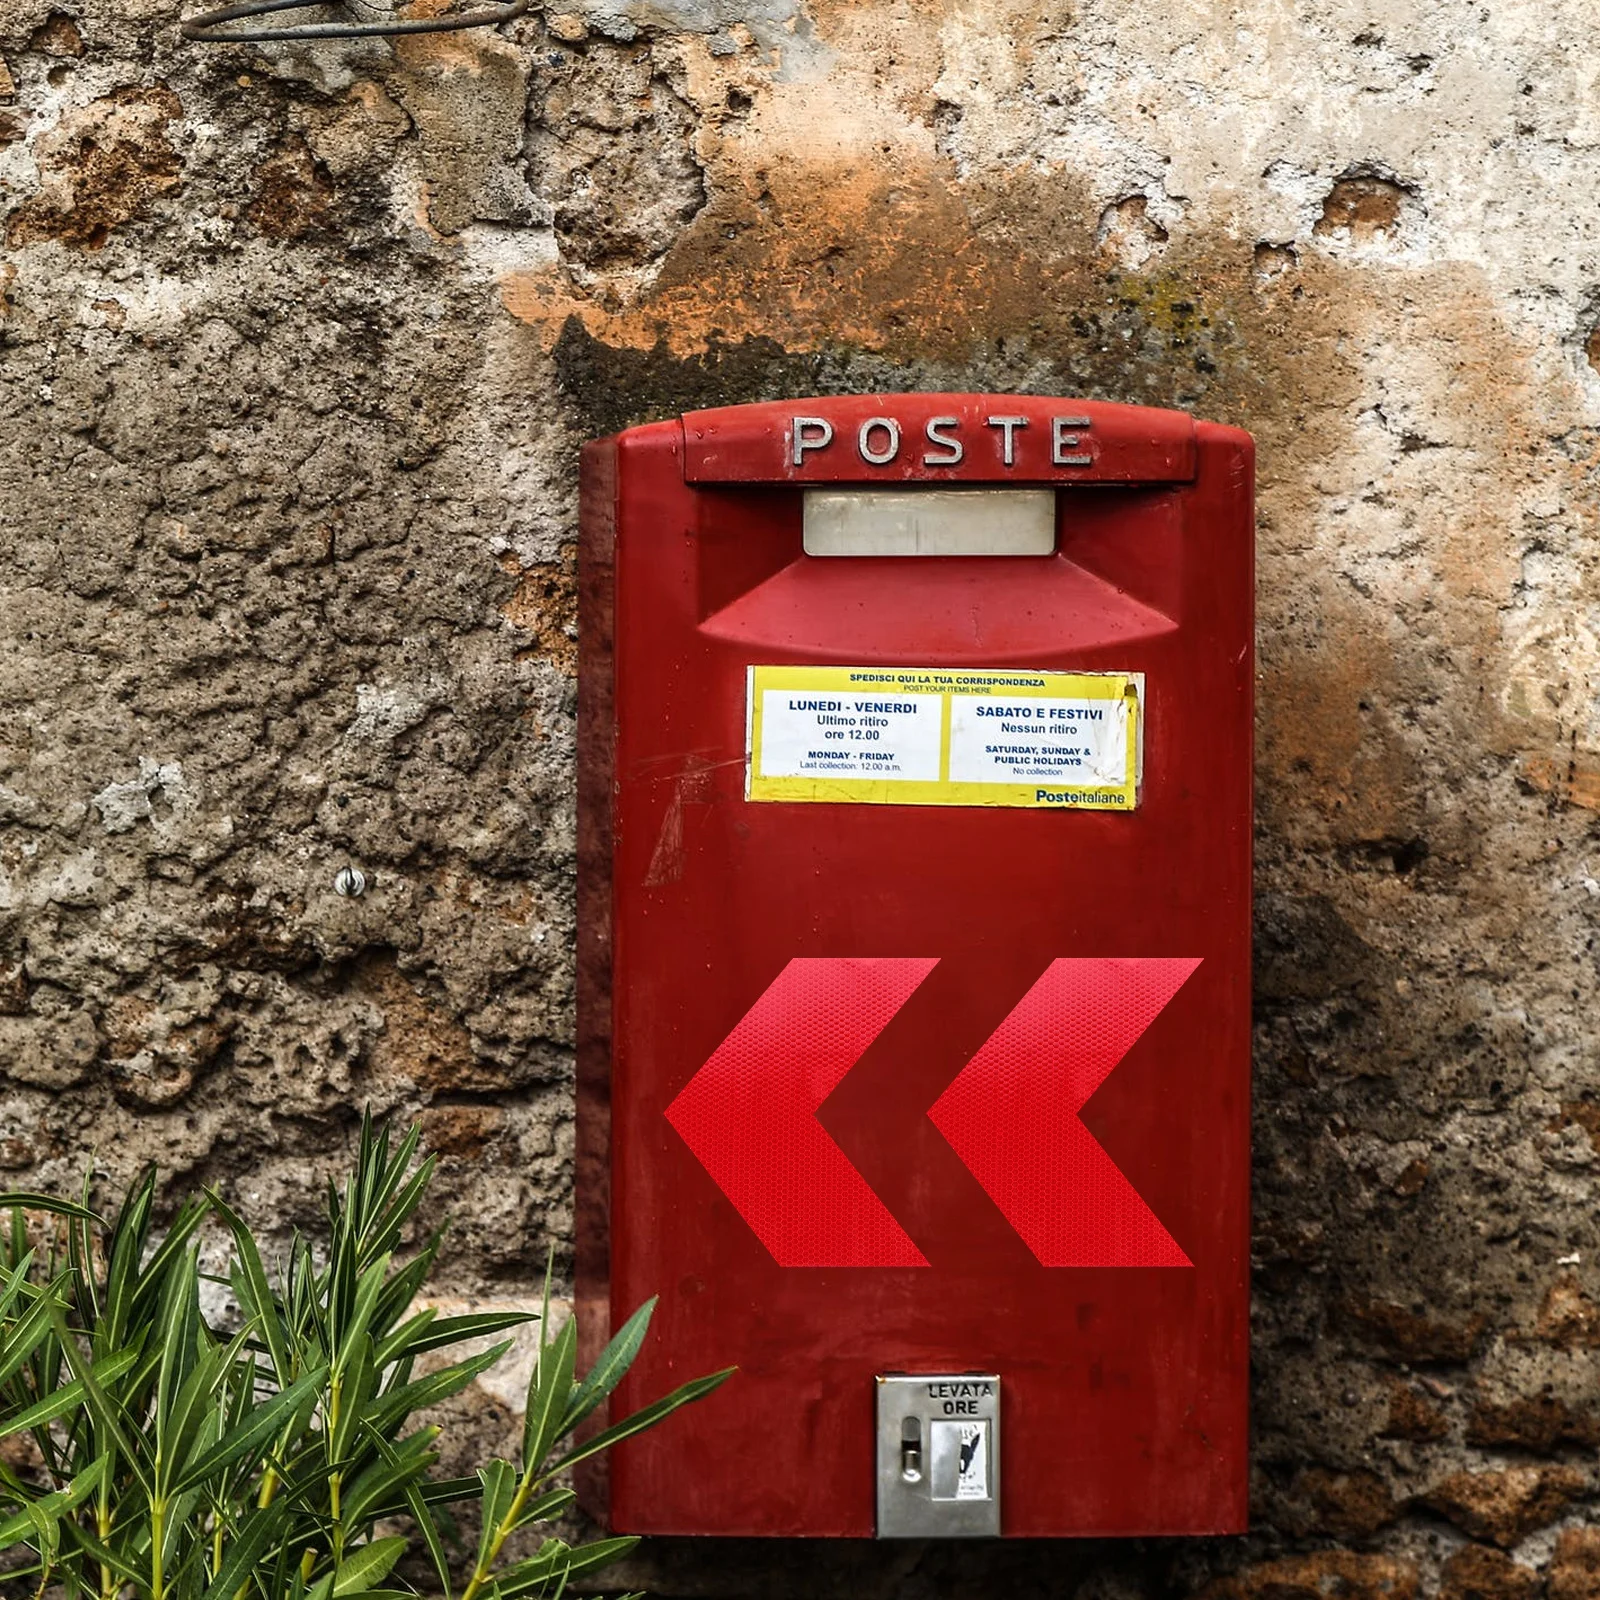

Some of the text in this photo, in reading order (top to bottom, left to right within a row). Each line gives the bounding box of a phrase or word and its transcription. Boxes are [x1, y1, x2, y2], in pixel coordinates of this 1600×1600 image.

[792, 416, 1093, 466] POSTE
[850, 674, 1046, 687] SPEDISCI QUI LA TUA CORRISPONDENZA
[971, 686, 992, 694] HERE
[789, 700, 842, 712] LUNEDI
[855, 702, 917, 714] VENERDI
[976, 706, 1103, 721] SABATO E FESTIVI
[817, 714, 889, 727] Ultimo ritiro
[825, 729, 880, 740] ore 12.00
[1001, 722, 1078, 735] Nessun ritiro
[808, 751, 851, 760] MONDAY
[859, 752, 895, 761] FRIDAY
[985, 745, 1091, 756] SATURDAY, SUNDAY &
[800, 761, 818, 769] Last
[818, 761, 858, 770] collection:
[861, 762, 883, 771] 12.00
[994, 756, 1082, 766] PUBLIC HOLIDAYS
[1012, 767, 1063, 776] No collection
[1036, 789, 1125, 804] Posteitaliane
[928, 1383, 993, 1398] LEVATA
[943, 1400, 979, 1415] ORE
